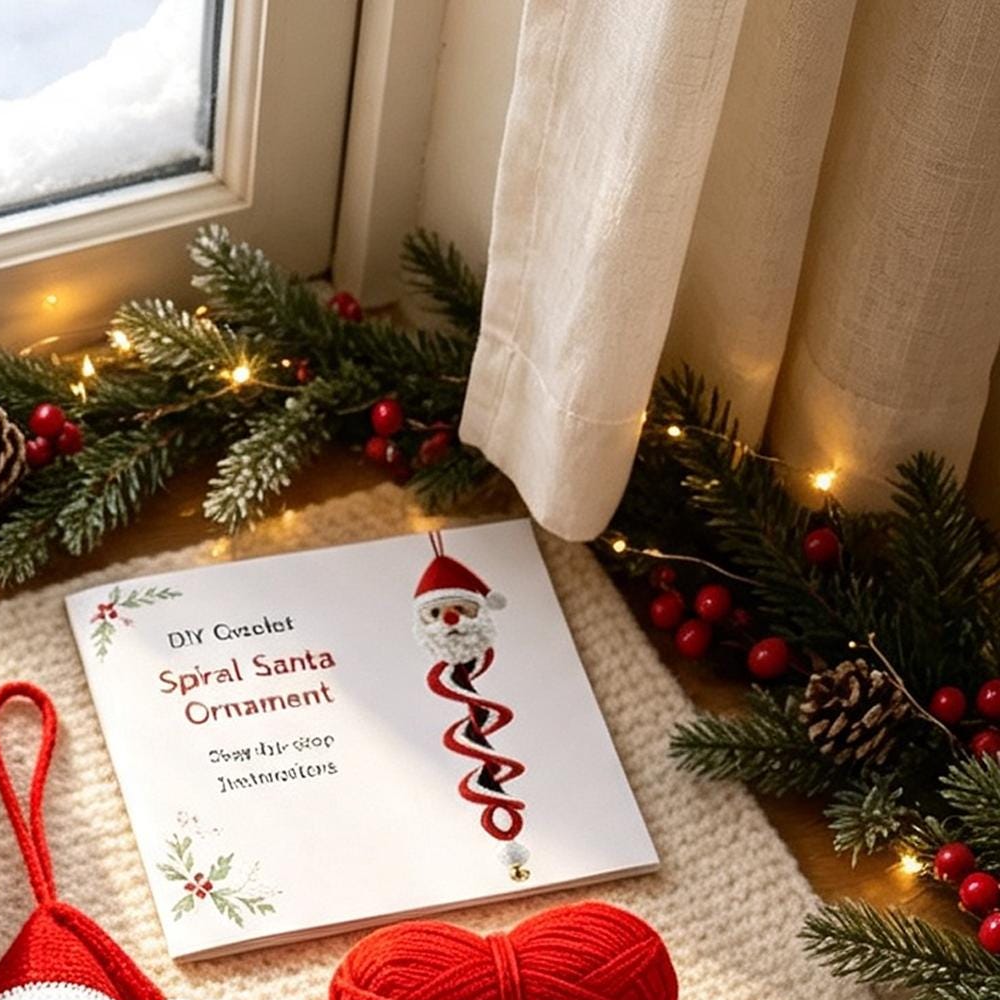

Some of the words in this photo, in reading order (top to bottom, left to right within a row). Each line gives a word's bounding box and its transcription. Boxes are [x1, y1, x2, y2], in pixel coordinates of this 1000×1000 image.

[168, 628, 204, 649] DIY
[159, 658, 243, 695] Spiral
[252, 650, 336, 676] Santa
[185, 682, 335, 725] Ornament
